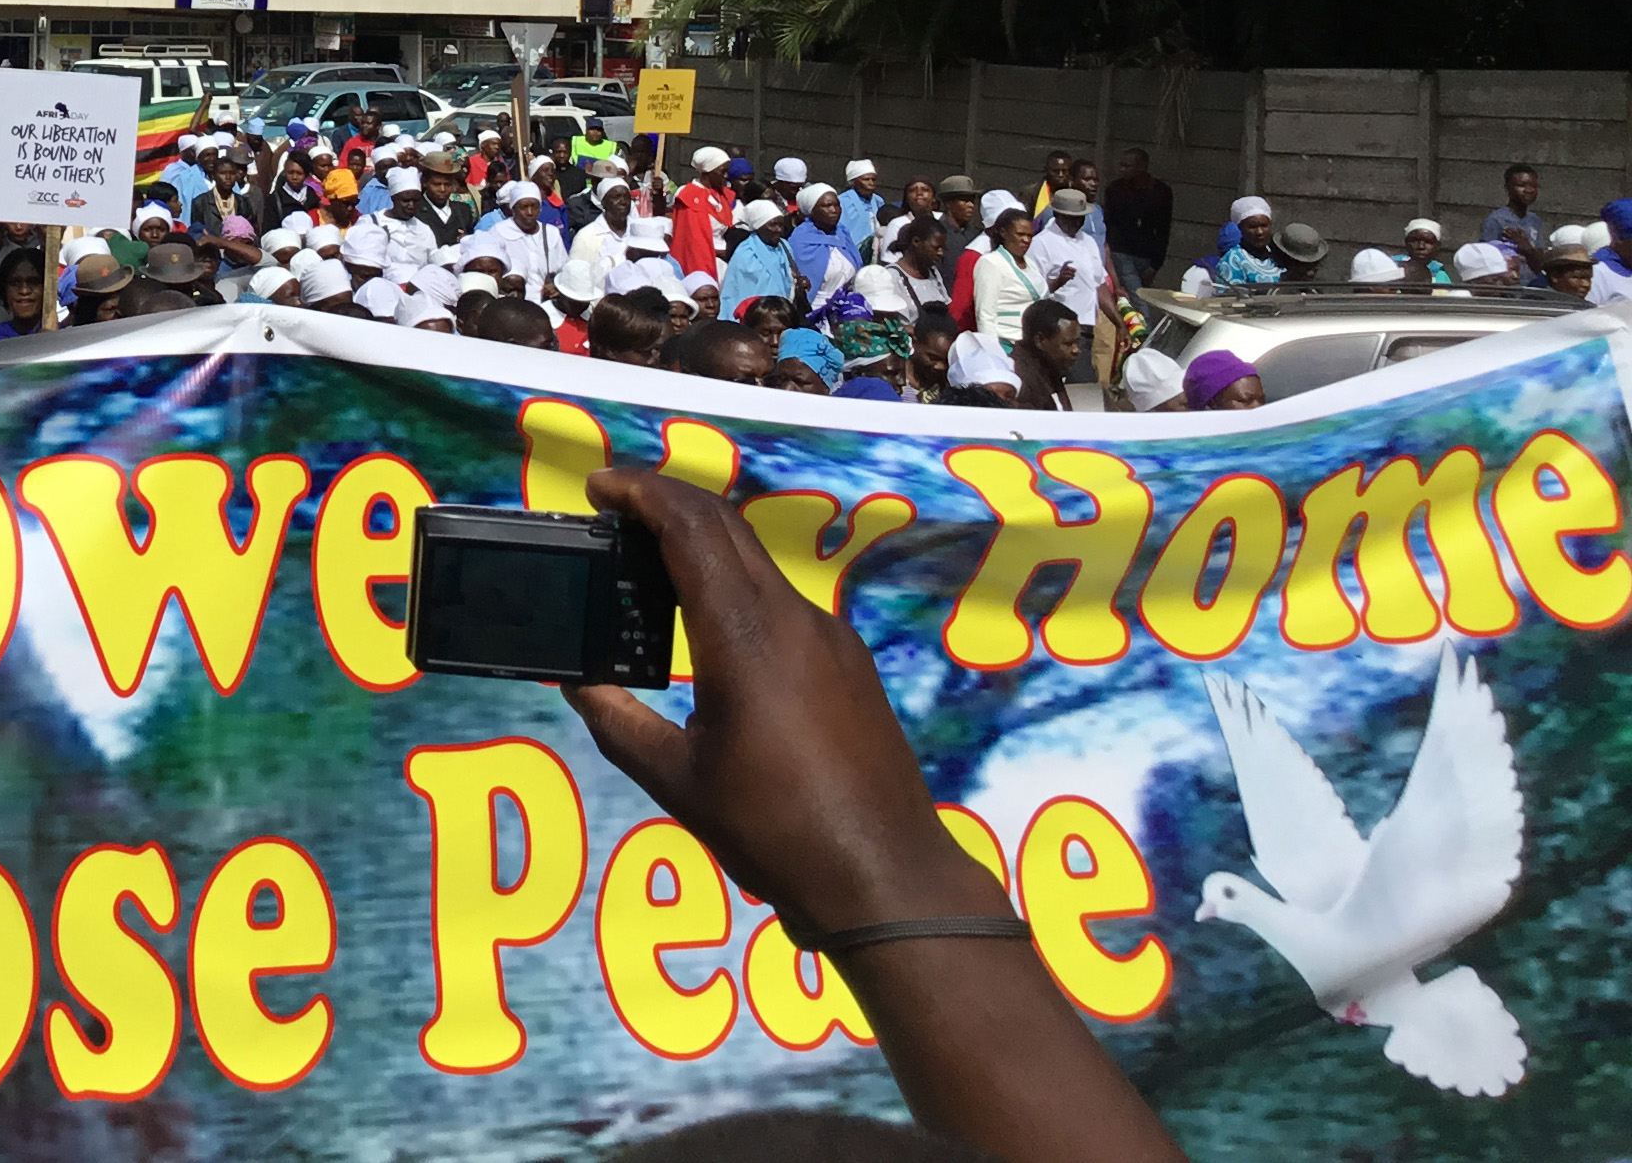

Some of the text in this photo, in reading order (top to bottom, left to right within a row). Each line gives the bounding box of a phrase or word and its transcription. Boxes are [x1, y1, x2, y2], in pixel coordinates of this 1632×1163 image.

[11, 123, 118, 146] OUR LIBERATION
[17, 141, 104, 165] IS BOUND ON
[14, 163, 106, 186] EACH OTHER'S
[37, 191, 60, 203] ZCC
[942, 427, 1632, 671] Home
